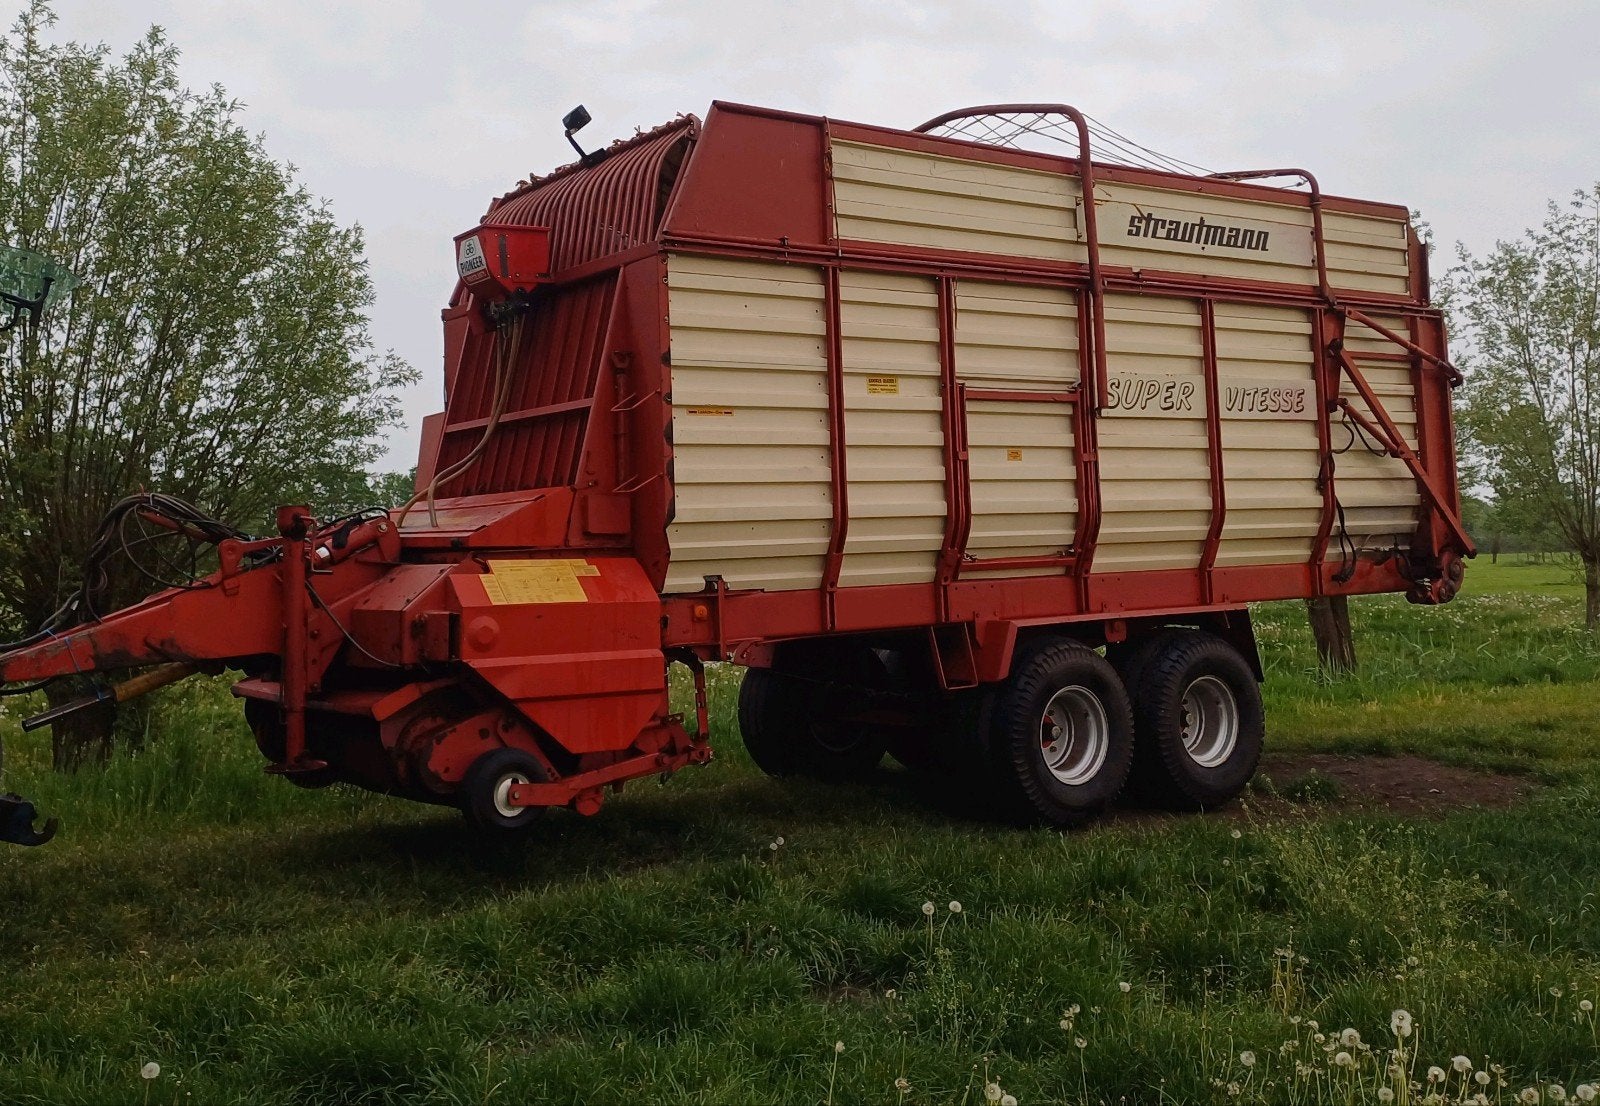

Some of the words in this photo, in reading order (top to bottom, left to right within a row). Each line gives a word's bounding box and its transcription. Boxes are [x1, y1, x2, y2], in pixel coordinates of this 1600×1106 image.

[1127, 213, 1269, 251] strautmann
[460, 255, 485, 274] PIONEER
[1107, 378, 1195, 410] SUPER
[1225, 387, 1305, 413] VITESSE
